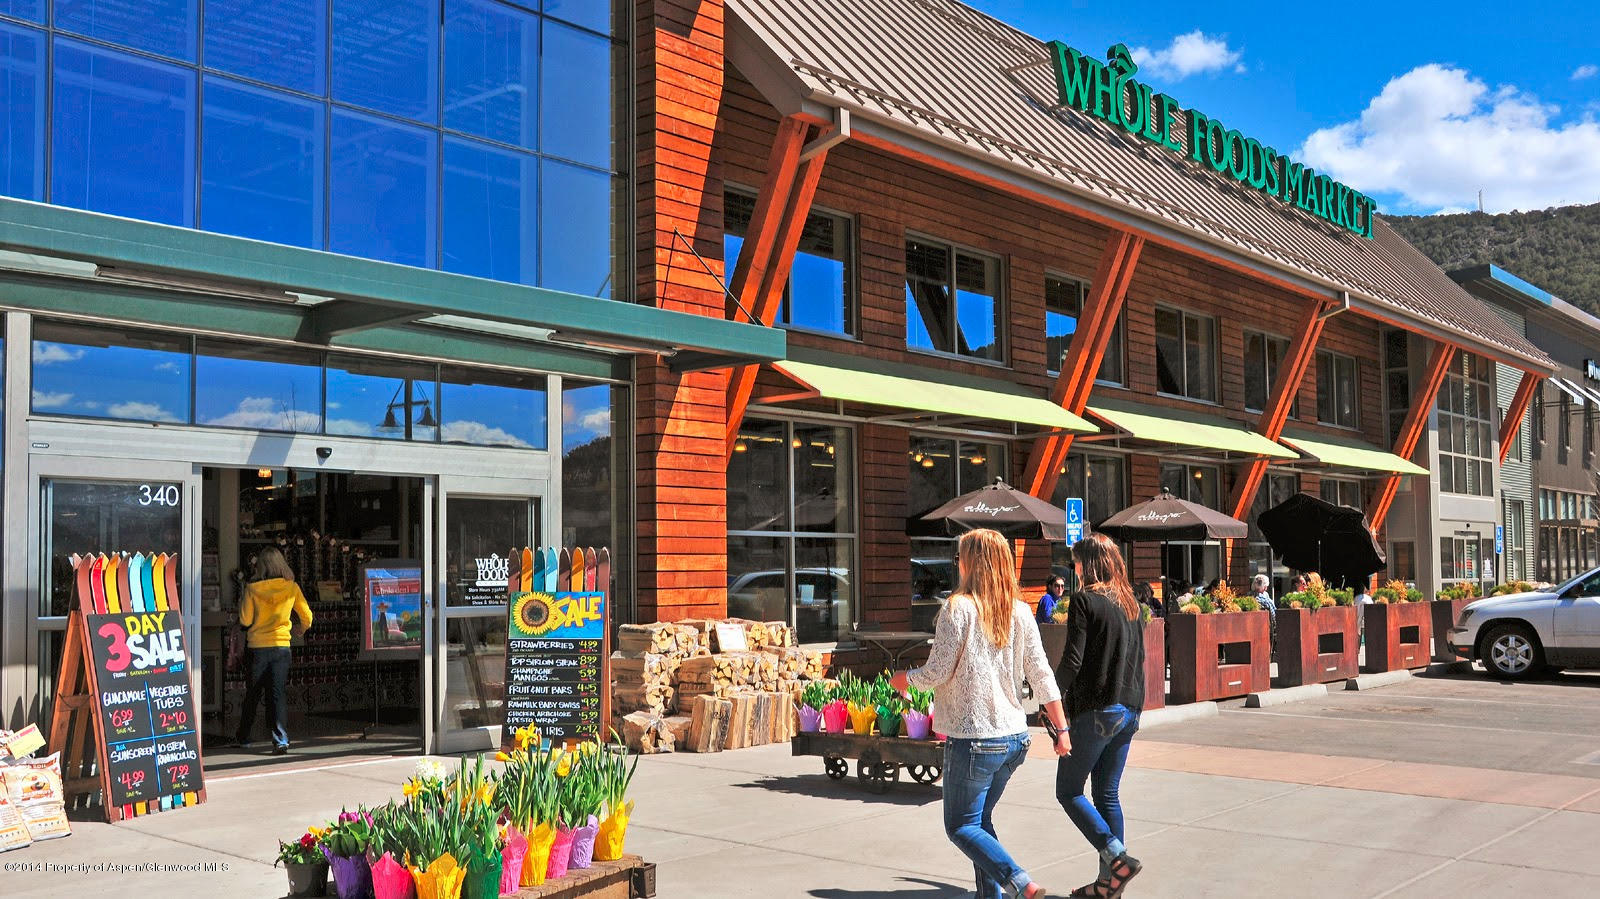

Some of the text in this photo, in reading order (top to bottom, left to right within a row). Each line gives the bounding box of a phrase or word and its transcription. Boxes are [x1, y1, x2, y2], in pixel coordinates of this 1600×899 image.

[1047, 40, 1376, 240] WHOLE FOODS MARKET
[139, 484, 179, 506] 340
[550, 595, 602, 631] SALE
[125, 612, 165, 636] DAY
[98, 622, 131, 672] 3
[126, 629, 185, 670] SALE
[510, 641, 574, 650] STRAWBERRIES
[509, 657, 525, 666] TOP
[526, 658, 554, 666] SIRLOIN
[555, 659, 579, 667] STEAK
[510, 667, 553, 675] CHAMPAGNE
[513, 674, 549, 682] MANGOS
[149, 684, 188, 699] VEGETABLE
[551, 686, 573, 695] BARS
[103, 690, 146, 707] GUACAMOLE
[153, 697, 184, 710] TUBS
[539, 701, 557, 709] BABY
[546, 727, 565, 736] IRIS
[110, 745, 155, 763] SUNSCREEN
